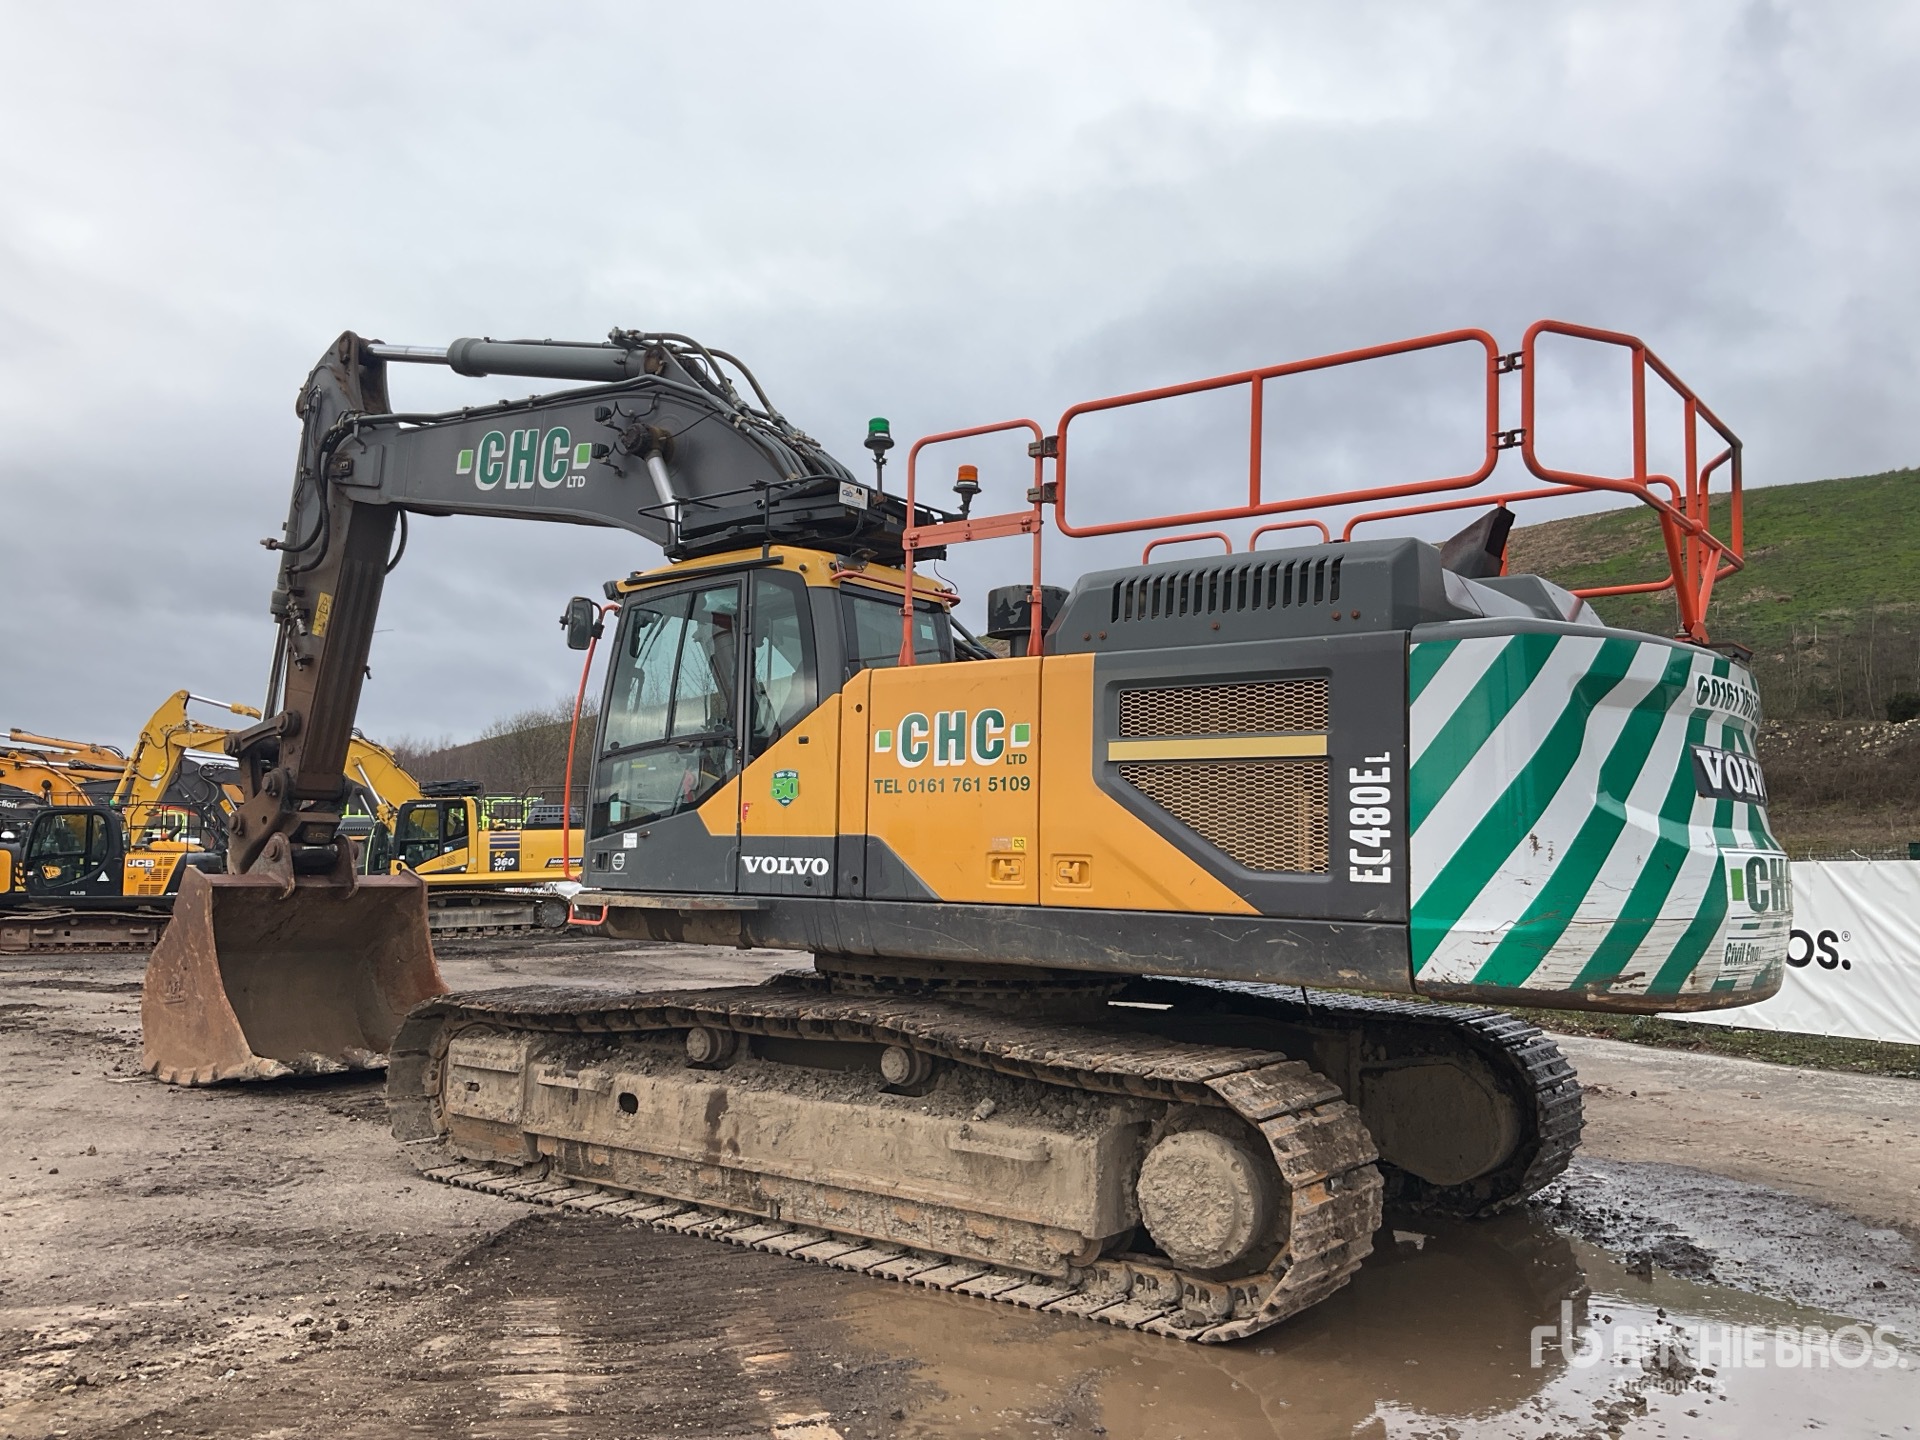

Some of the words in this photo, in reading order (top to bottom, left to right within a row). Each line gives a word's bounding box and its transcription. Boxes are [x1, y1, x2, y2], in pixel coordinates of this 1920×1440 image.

[475, 426, 571, 491] CHC
[566, 475, 586, 488] LTD
[1709, 678, 1739, 712] 0161
[896, 708, 1005, 768] CHC
[1005, 753, 1027, 765] LTD
[1696, 749, 1767, 798] VOLV
[771, 777, 799, 800] 50
[874, 779, 903, 794] TEL
[907, 778, 945, 794] 0161
[952, 777, 981, 793] 761
[988, 775, 1031, 792] 5109
[127, 860, 155, 868] JCB
[494, 857, 515, 866] 360
[742, 856, 829, 875] VOLVO
[1725, 943, 1746, 966] Civil
